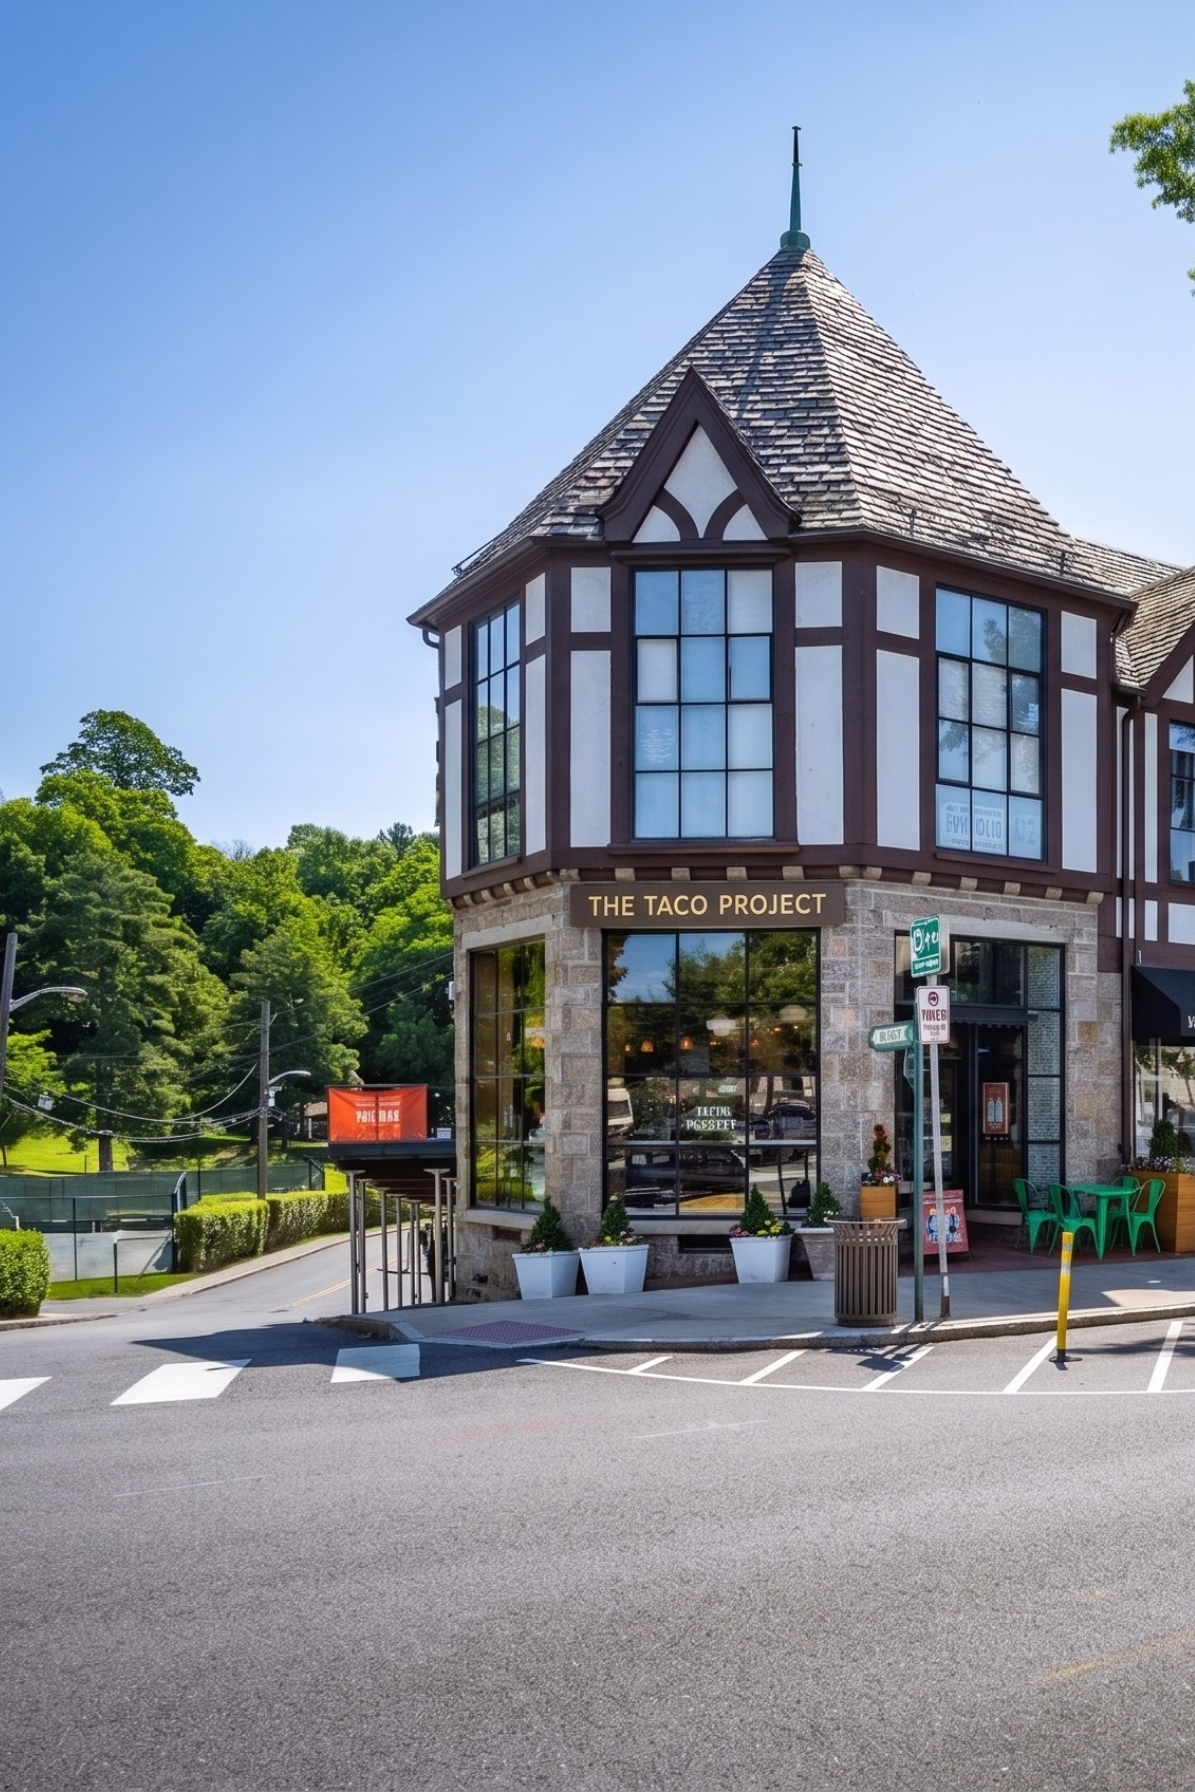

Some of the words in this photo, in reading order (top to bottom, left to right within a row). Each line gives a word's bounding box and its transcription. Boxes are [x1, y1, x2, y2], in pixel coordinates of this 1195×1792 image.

[588, 895, 635, 917] THE
[644, 894, 708, 916] TACO
[719, 893, 826, 915] PROJECT
